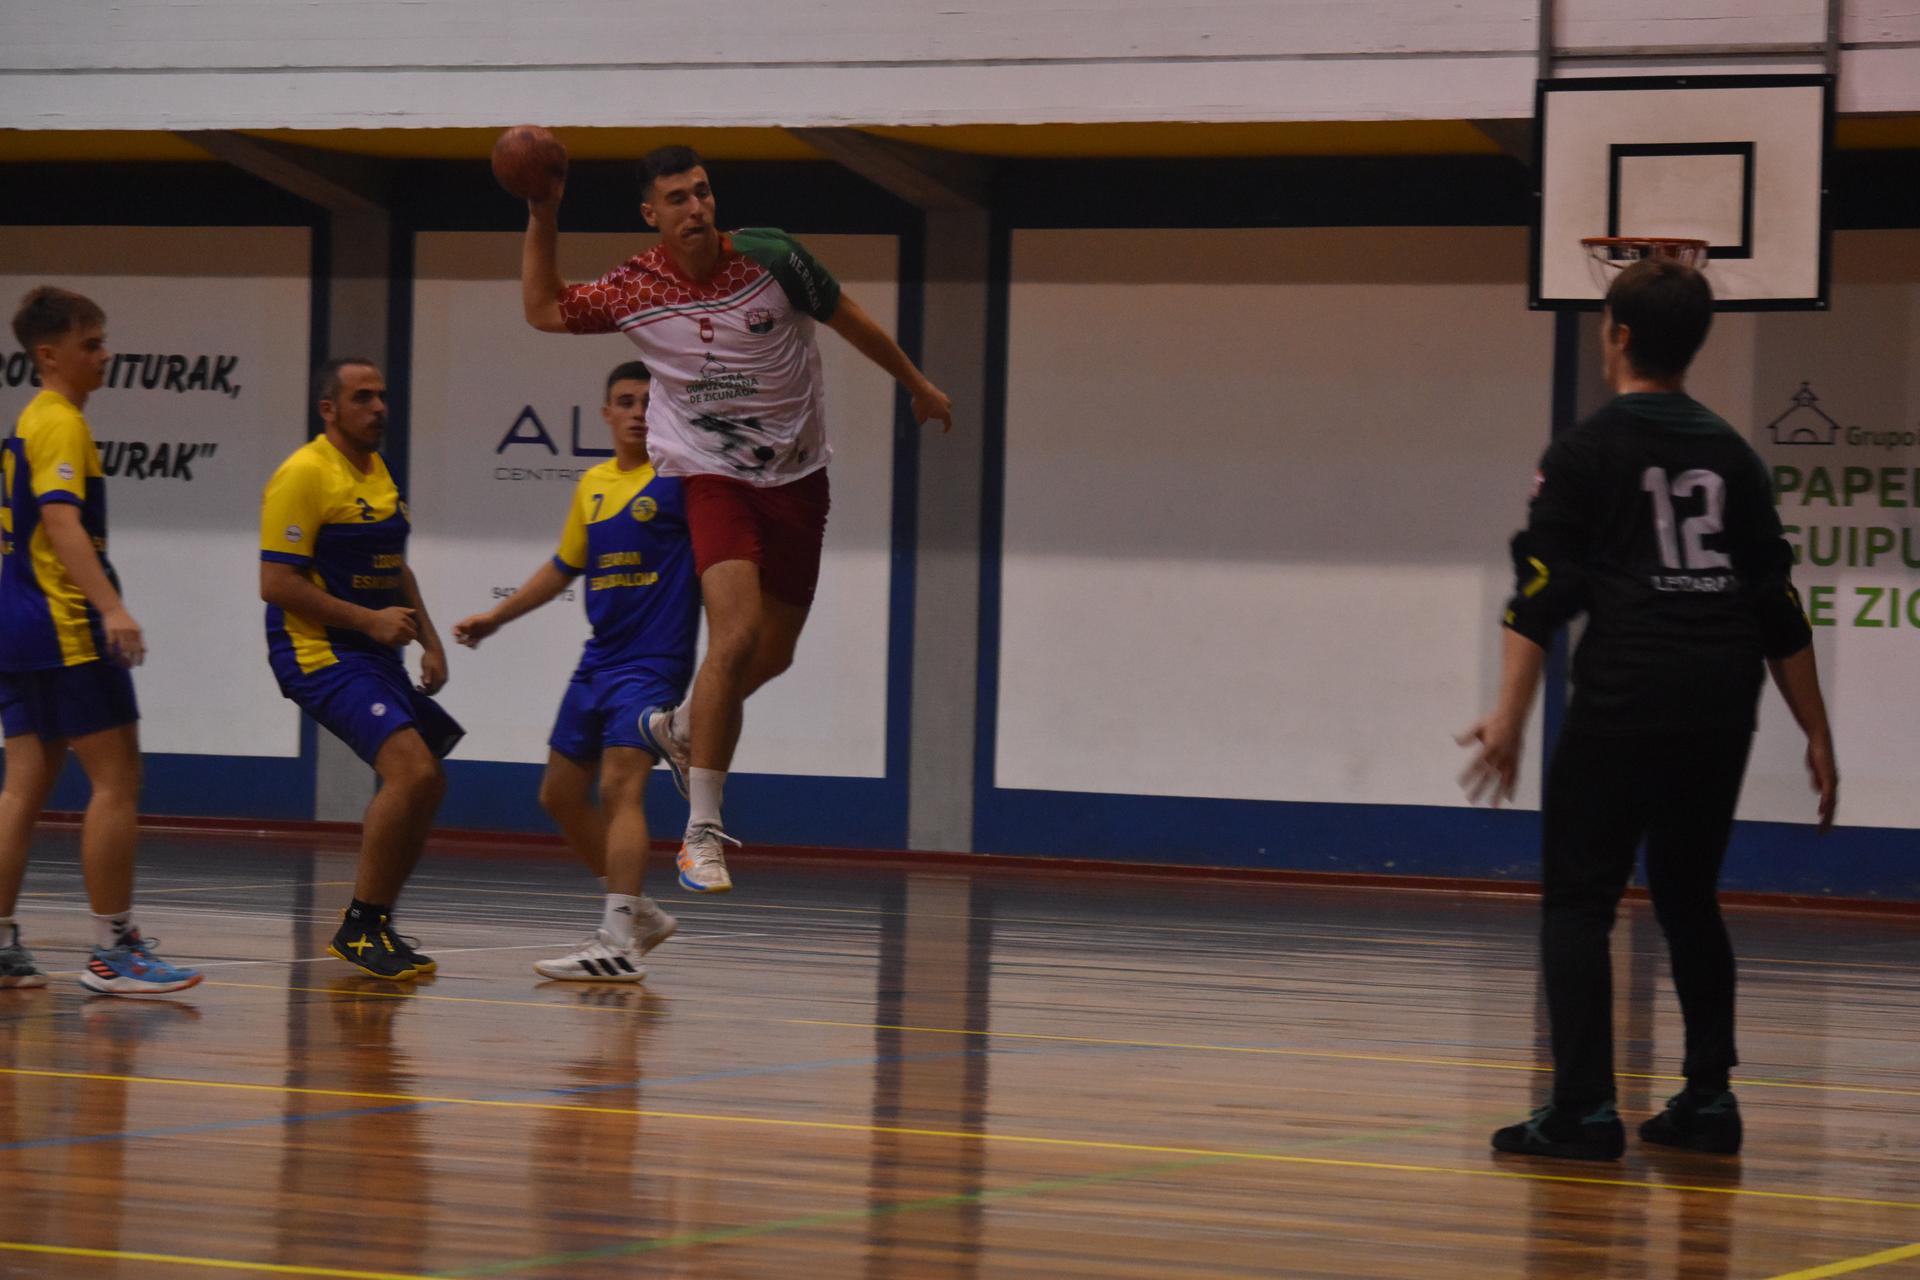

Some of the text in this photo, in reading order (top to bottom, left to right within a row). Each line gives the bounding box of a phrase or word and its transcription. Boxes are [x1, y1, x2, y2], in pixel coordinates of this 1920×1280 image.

[1847, 425, 1920, 451] Grupo
[1772, 465, 1920, 508] PAPE
[356, 497, 376, 521] 2
[592, 494, 604, 521] 7
[1640, 466, 1732, 570] 12
